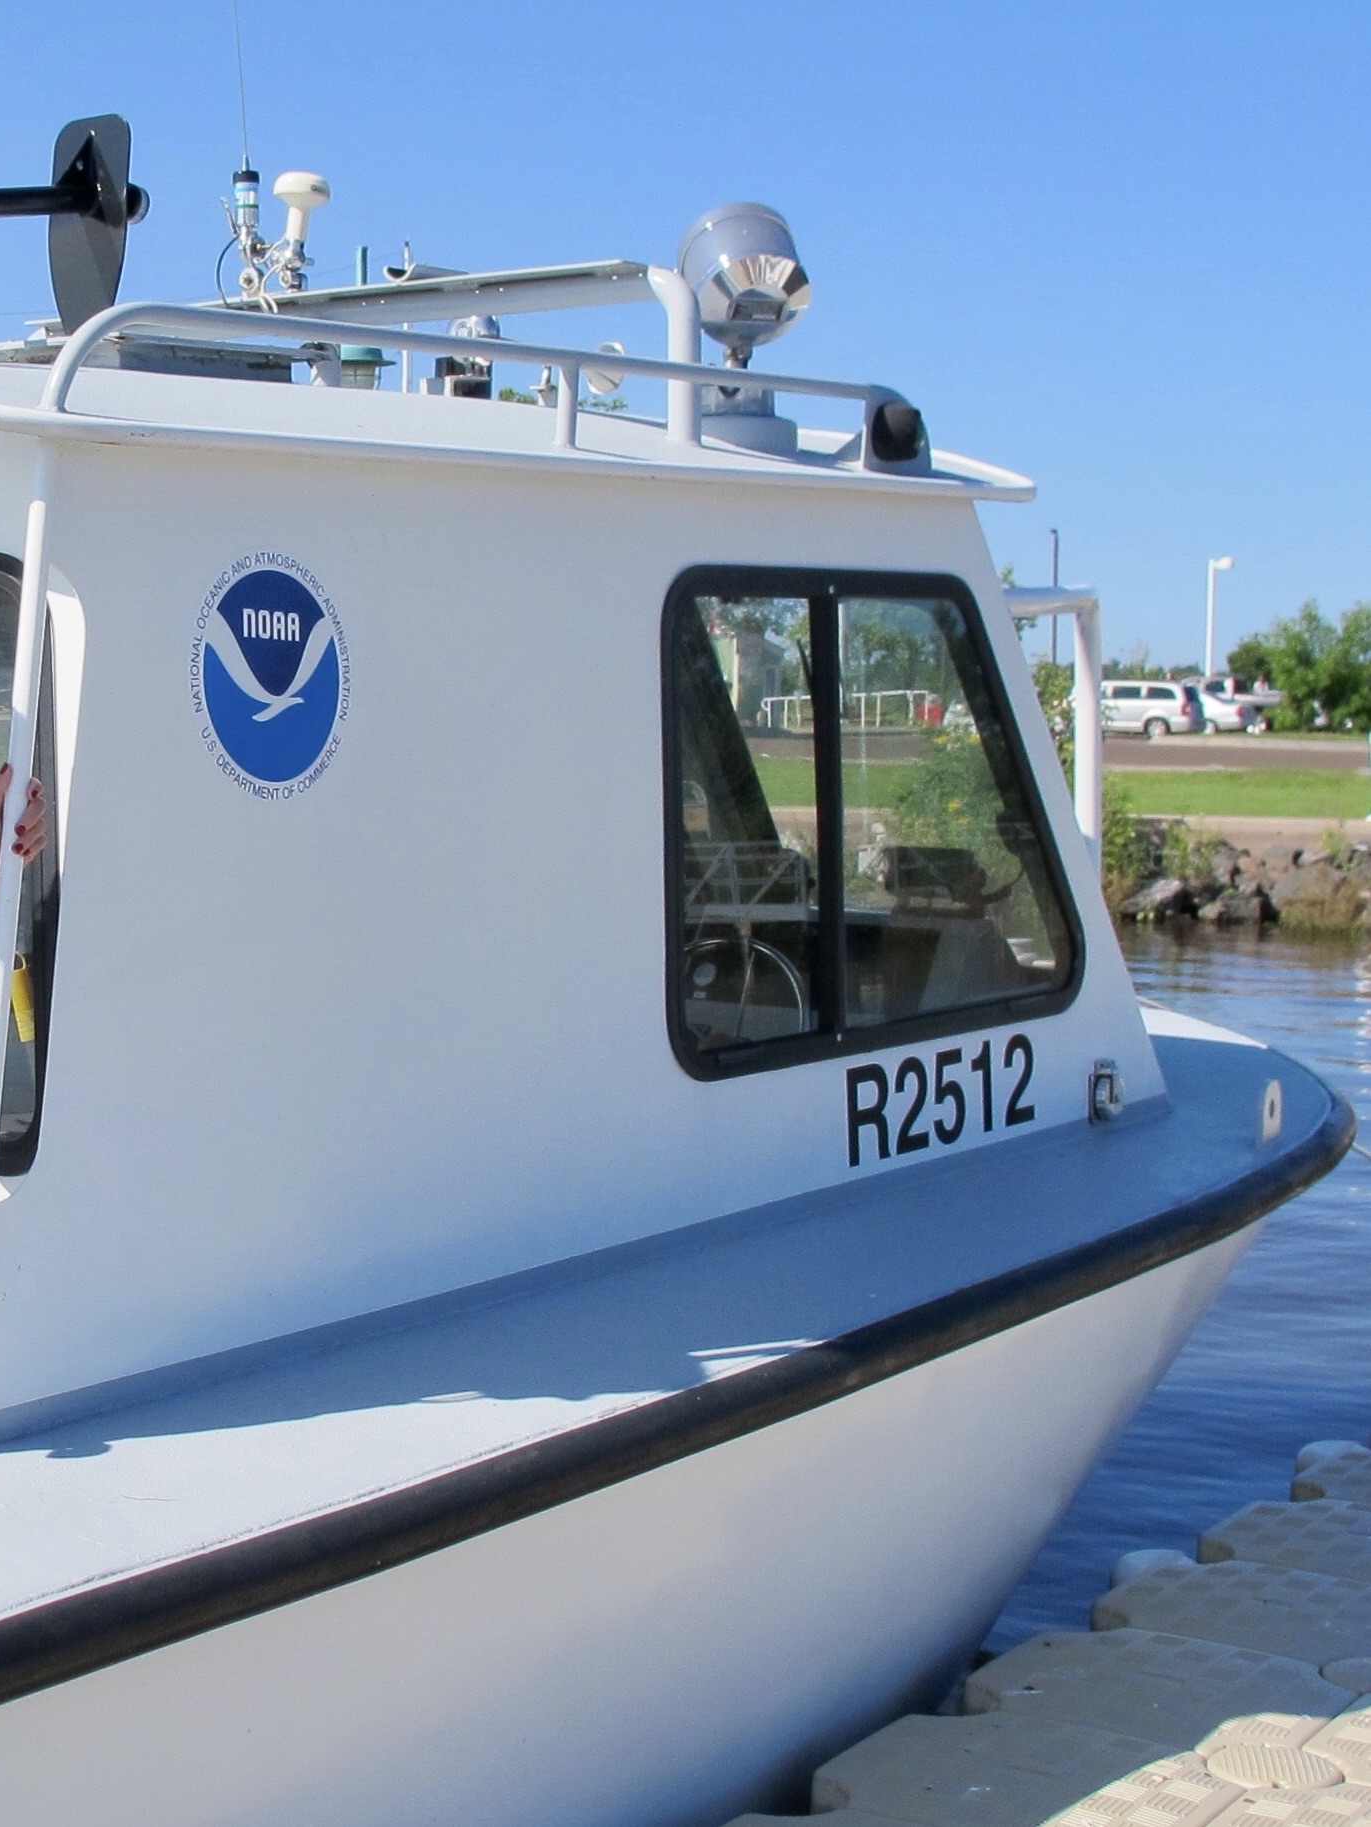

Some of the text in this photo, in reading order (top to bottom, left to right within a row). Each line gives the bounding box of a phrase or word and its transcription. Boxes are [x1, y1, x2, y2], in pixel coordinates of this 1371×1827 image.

[189, 551, 352, 722] NATIONAL OCEANIC AND ATMOSPHERIC ADMINISTRATION
[242, 608, 301, 643] NOAA
[200, 726, 342, 801] U.S. DEPARTMENT OF COMMERCE
[846, 1032, 1036, 1168] R2512
